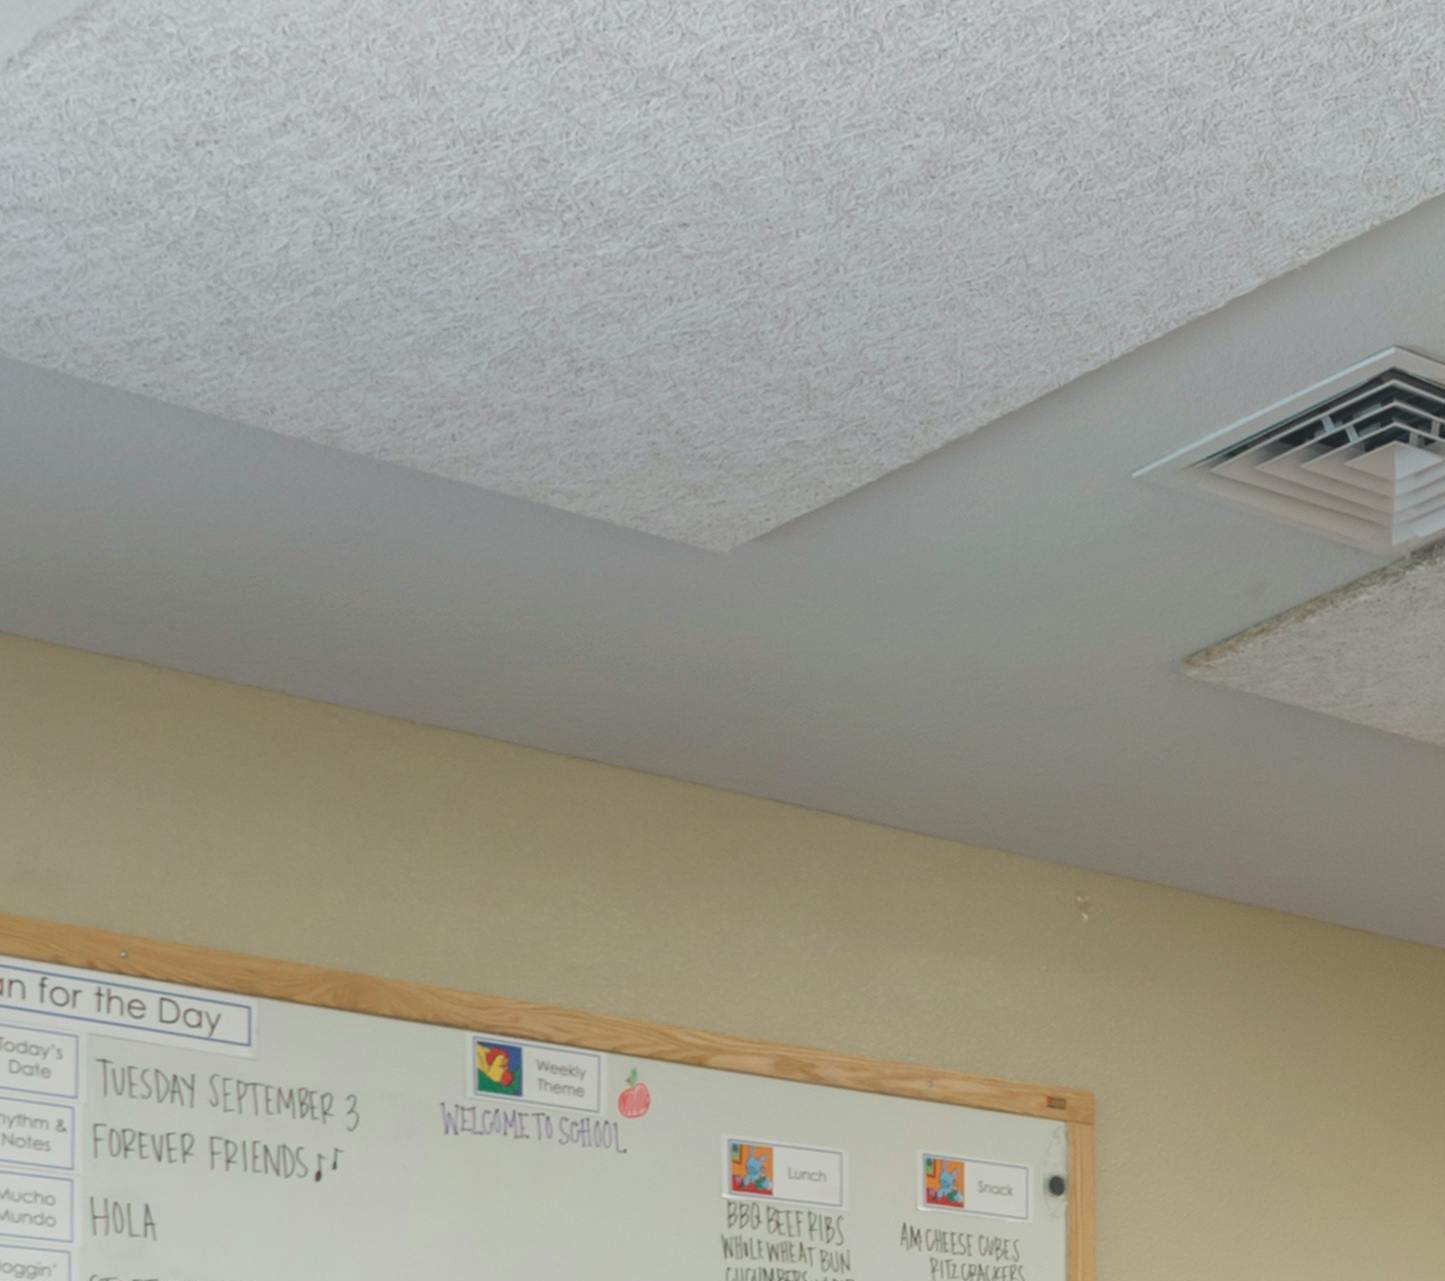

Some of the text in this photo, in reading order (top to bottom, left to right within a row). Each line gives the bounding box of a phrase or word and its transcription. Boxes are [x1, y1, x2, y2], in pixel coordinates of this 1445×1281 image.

[38, 976, 222, 1037] for the Day
[8, 1059, 52, 1080] Date
[536, 1059, 587, 1080] Weekly
[94, 1058, 361, 1132] TUESDAY SEPTEMBER 3
[537, 1077, 586, 1099] Theme
[54, 1119, 68, 1133] &
[1, 1131, 52, 1152] Notes
[92, 1123, 309, 1180] FOREVER FRIENDS
[787, 1166, 828, 1183] Lunch
[976, 1180, 1014, 1198] Snack
[89, 1196, 158, 1241] HOLA
[925, 1227, 974, 1258] CHEESE
